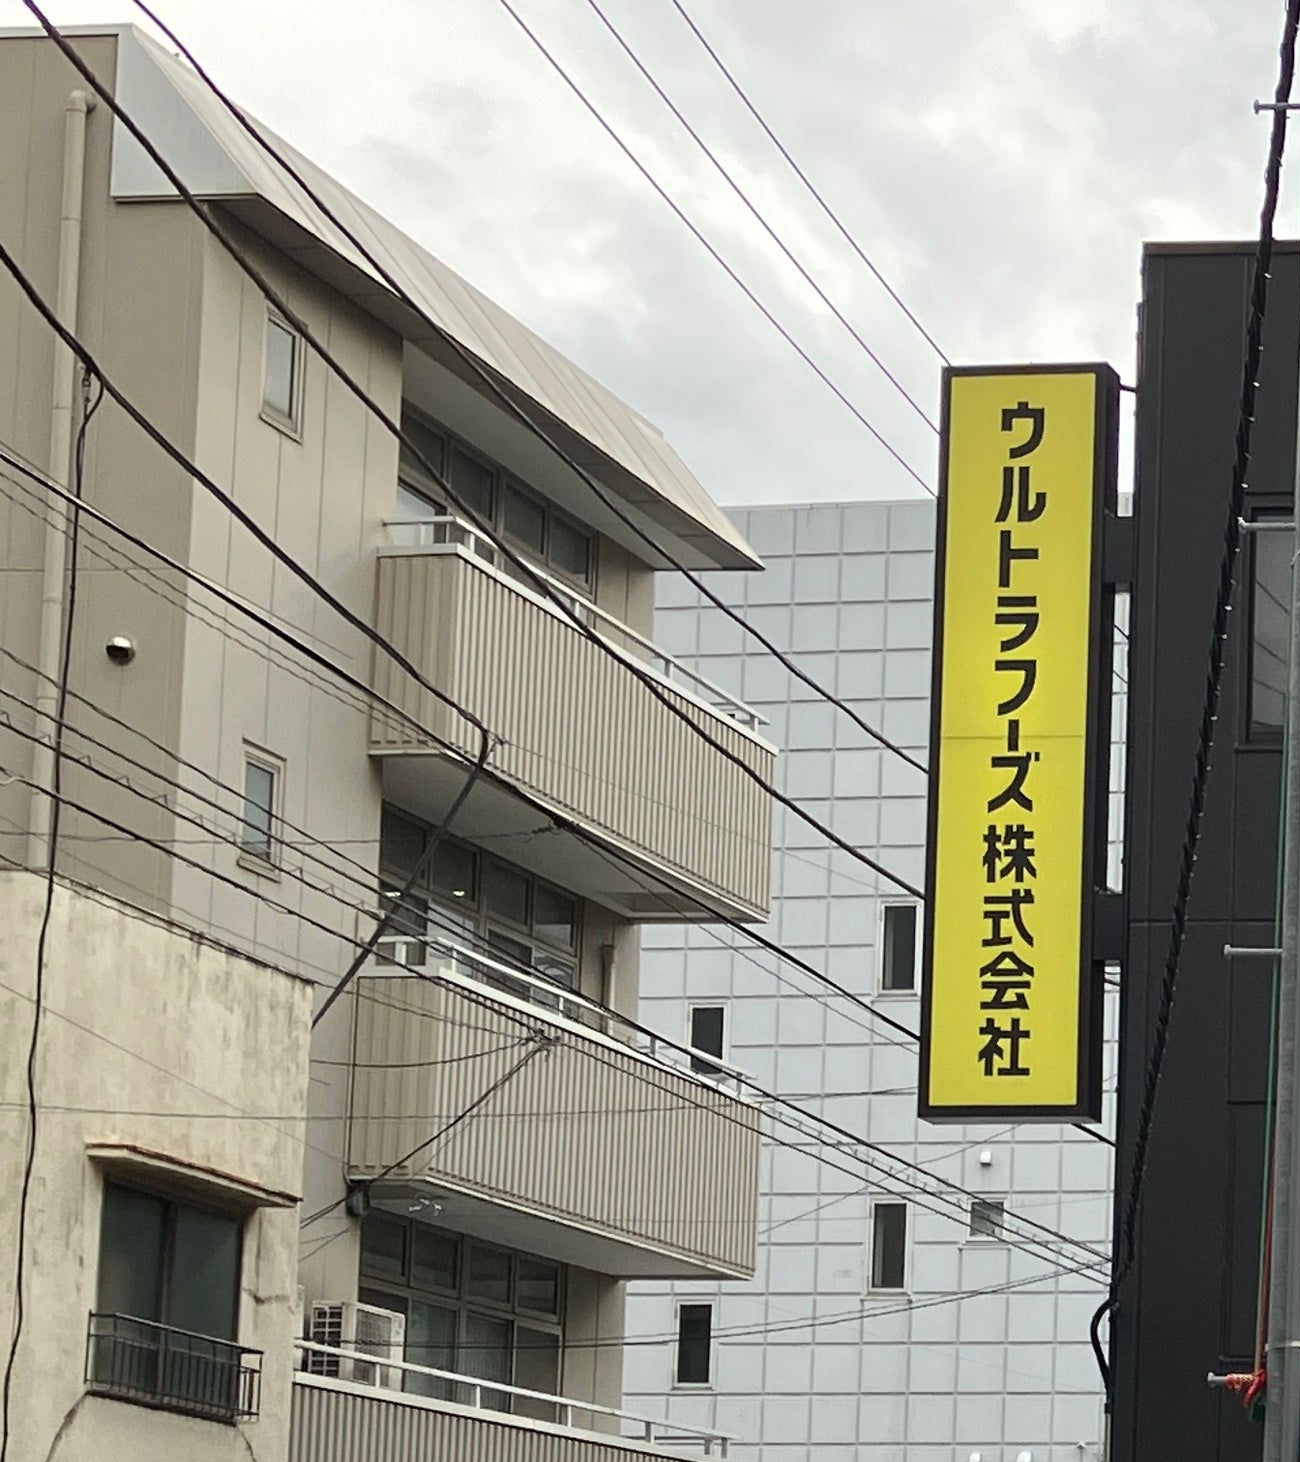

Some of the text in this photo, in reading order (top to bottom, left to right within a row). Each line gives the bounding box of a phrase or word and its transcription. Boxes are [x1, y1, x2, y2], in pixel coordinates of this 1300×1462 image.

[977, 400, 1047, 1079] ウルトラフーズ株式会社
